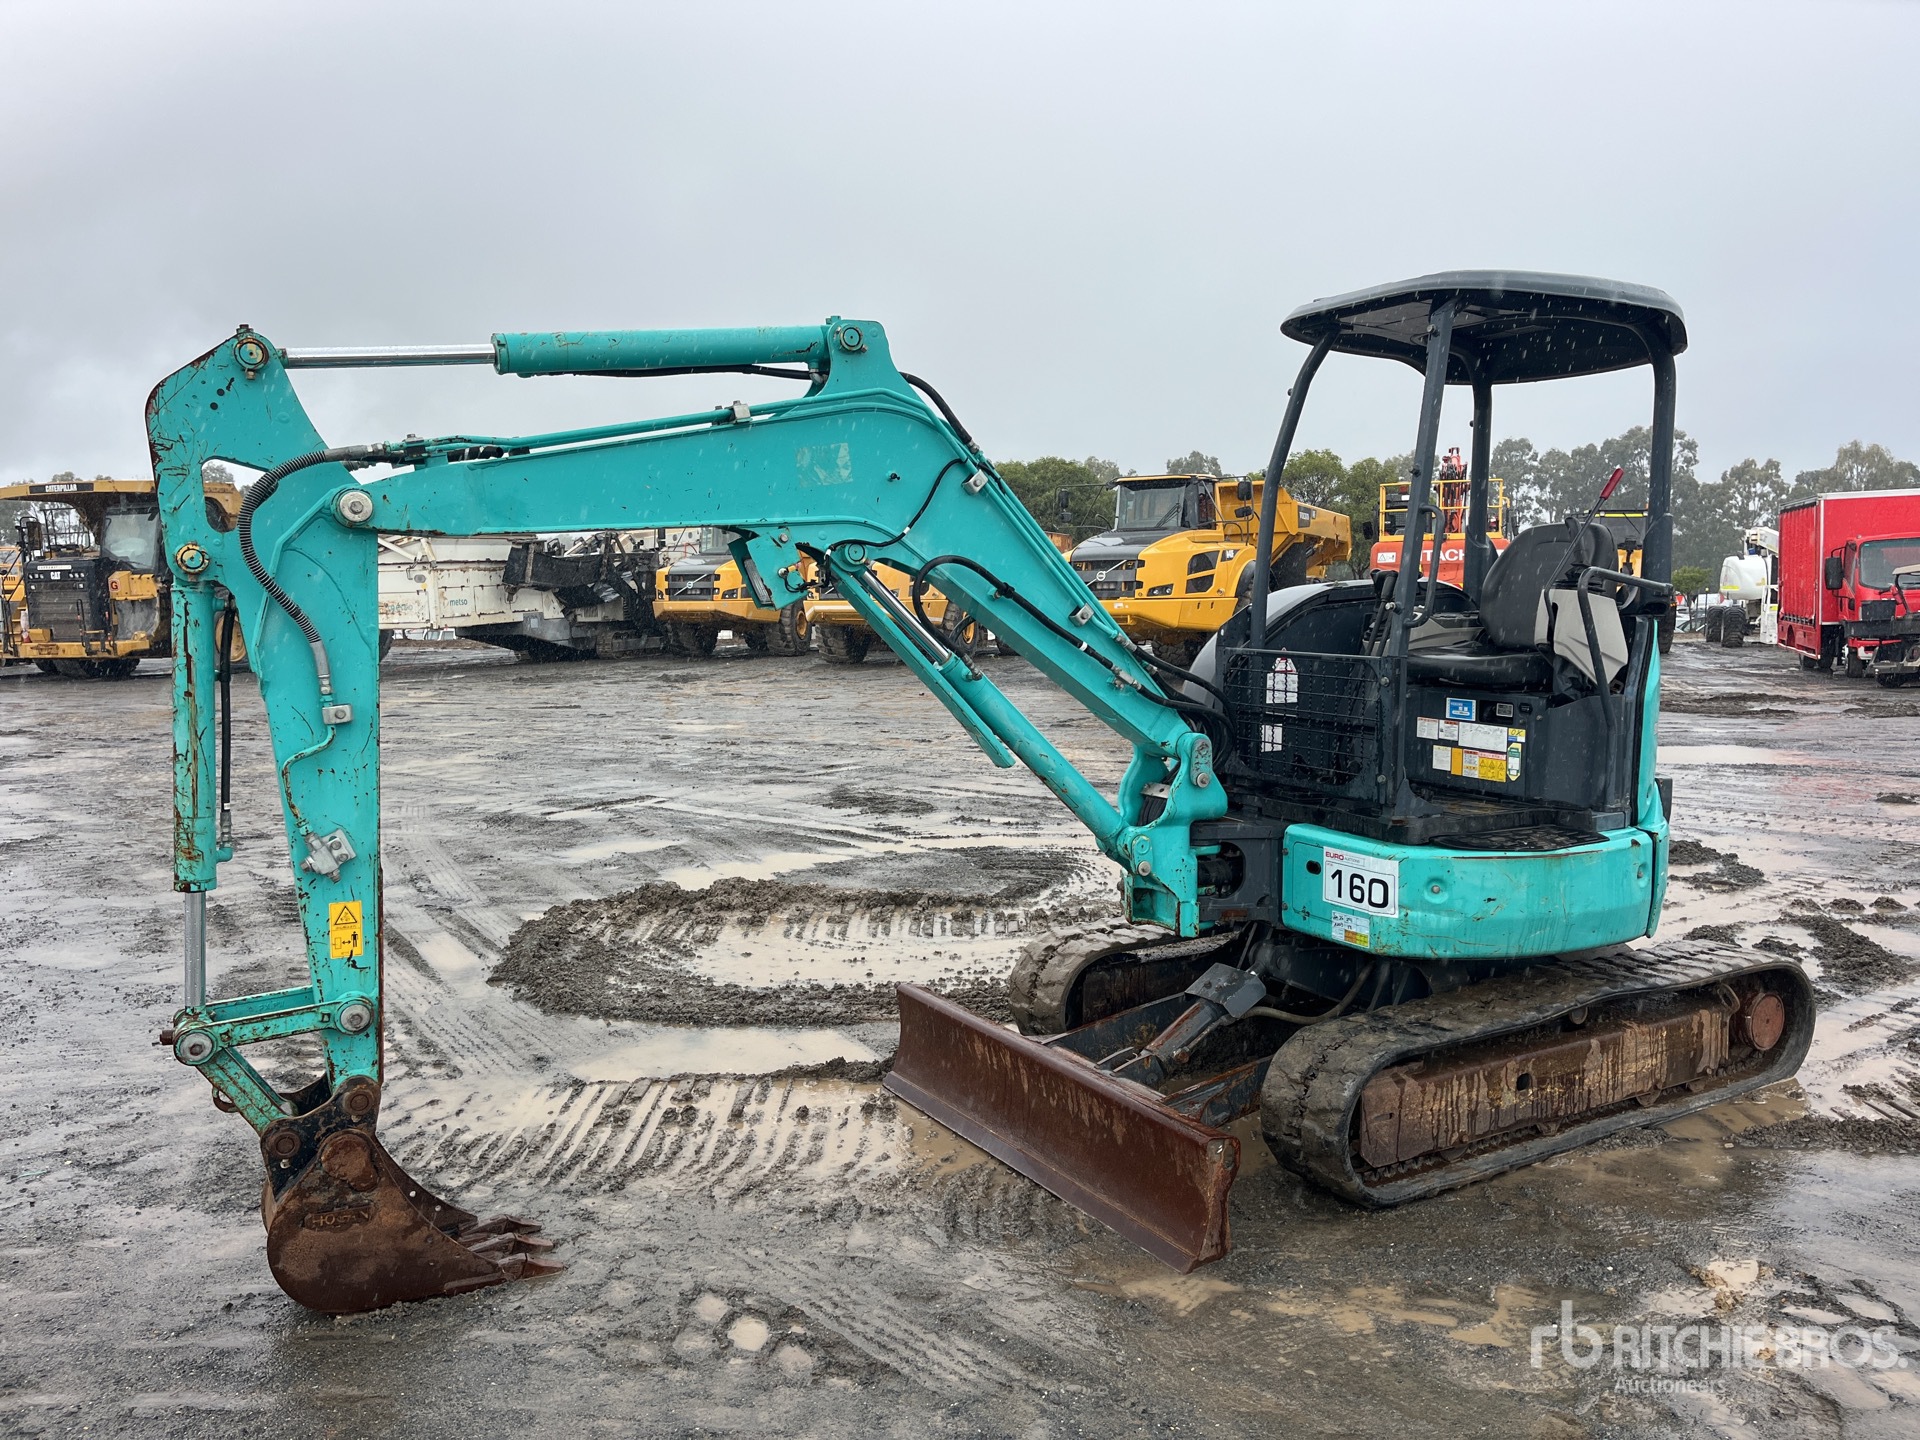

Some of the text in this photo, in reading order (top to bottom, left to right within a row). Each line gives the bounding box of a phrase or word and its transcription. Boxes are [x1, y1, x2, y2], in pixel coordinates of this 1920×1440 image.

[45, 483, 77, 492] CATERPILLAR
[50, 571, 61, 580] CAT
[110, 581, 118, 590] G
[449, 598, 468, 607] metso
[1325, 851, 1344, 861] EURO
[1330, 869, 1389, 909] 160
